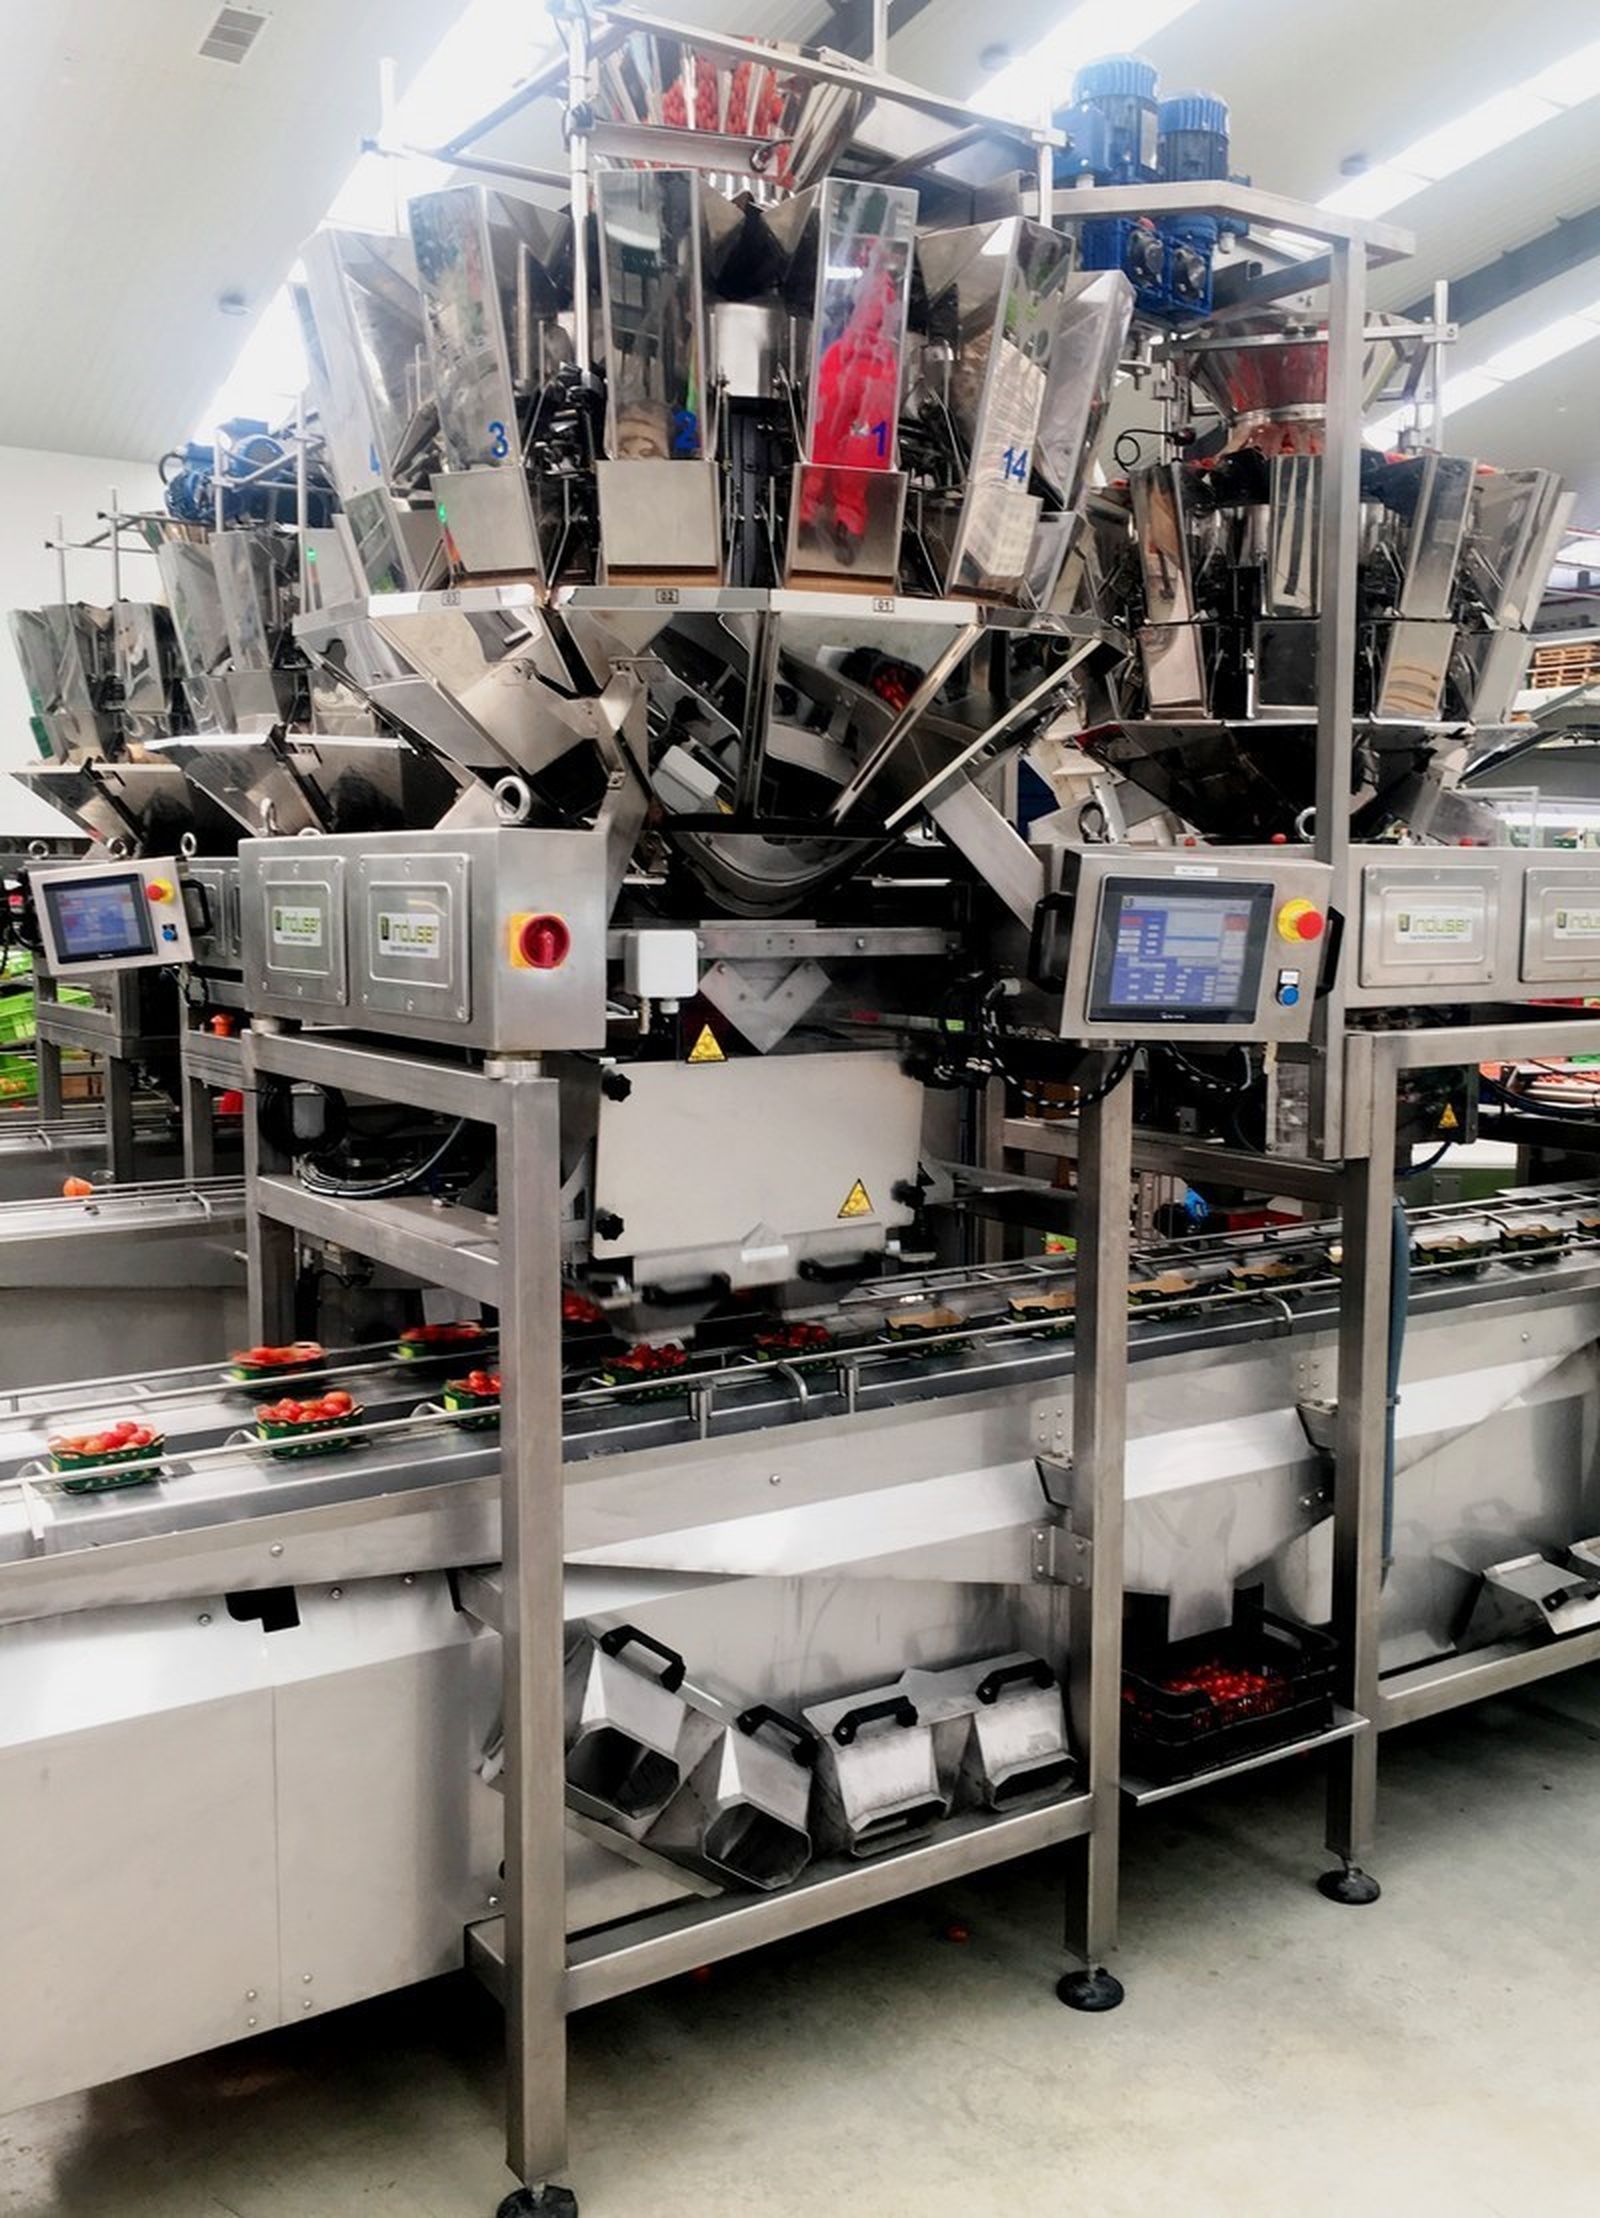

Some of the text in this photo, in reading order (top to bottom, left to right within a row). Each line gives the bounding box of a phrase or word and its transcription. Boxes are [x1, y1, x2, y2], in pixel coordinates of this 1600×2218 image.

[489, 421, 508, 458] 3
[675, 412, 698, 449] 2
[871, 420, 887, 457] 1
[1003, 446, 1028, 483] 14
